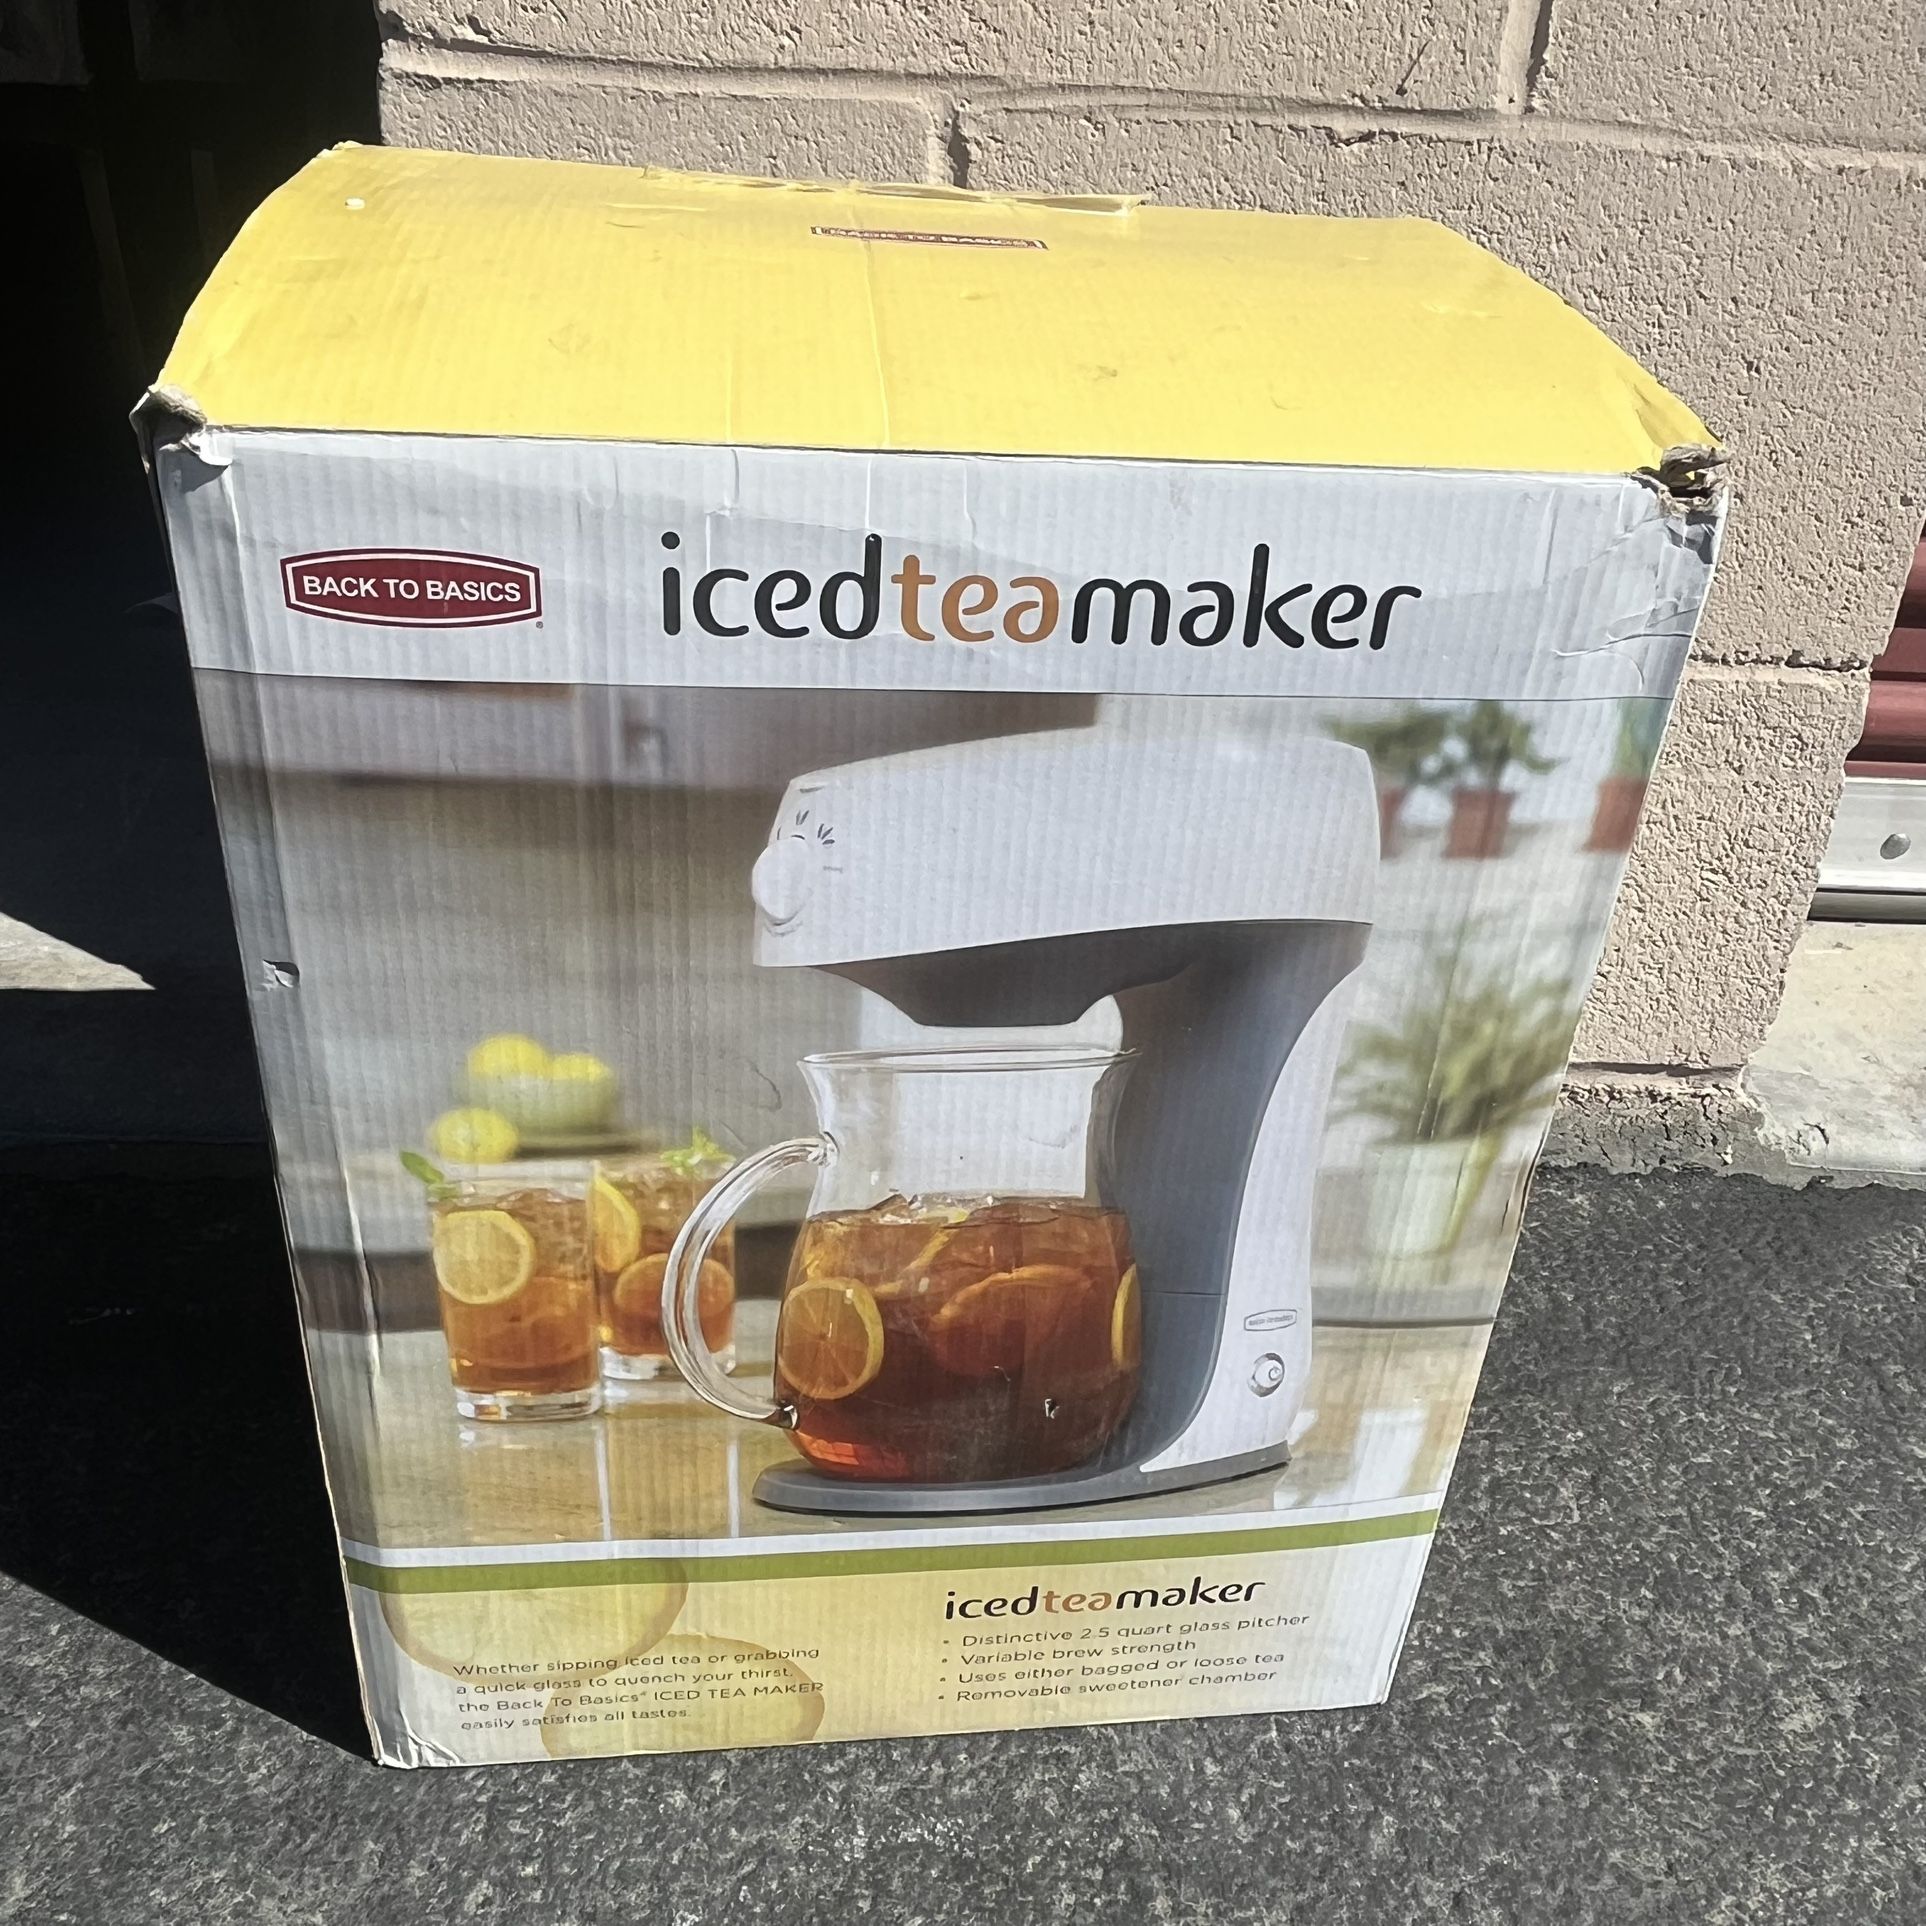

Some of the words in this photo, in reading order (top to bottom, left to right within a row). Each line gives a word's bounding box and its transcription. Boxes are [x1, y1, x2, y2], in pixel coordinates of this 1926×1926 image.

[302, 574, 379, 600] BACK
[382, 577, 420, 600] TO
[426, 579, 521, 603] BASICS
[661, 531, 1423, 651] icedteamaker
[963, 1631, 1073, 1647] Distinctive
[1117, 1623, 1172, 1638] quart
[1179, 1620, 1231, 1635] glass
[1237, 1615, 1310, 1630] pitcher
[453, 1663, 540, 1676] Whether
[547, 1658, 618, 1672] sipping
[625, 1656, 664, 1667] iced
[672, 1655, 701, 1665] tea
[708, 1654, 726, 1664] or
[734, 1649, 819, 1664] grabbing
[961, 1650, 1045, 1665] Variable
[1052, 1649, 1103, 1659] brew
[1111, 1640, 1196, 1656] strength
[959, 1672, 1007, 1683] Uses
[1014, 1667, 1074, 1680] either
[1081, 1660, 1159, 1675] bagged
[1166, 1660, 1188, 1670] or
[1194, 1656, 1248, 1667] loose
[1254, 1653, 1284, 1664] tea
[456, 1686, 467, 1695] a
[474, 1681, 527, 1695] quick
[533, 1679, 582, 1692] glass
[588, 1678, 607, 1687] to
[614, 1673, 685, 1686] quench
[692, 1673, 734, 1684] your
[458, 1703, 490, 1713] the
[496, 1699, 544, 1711] Back
[550, 1697, 573, 1707] To
[654, 1690, 701, 1701] ICED
[707, 1688, 747, 1699] TEA
[753, 1682, 824, 1696] MAKER
[957, 1685, 1071, 1702] Removable
[1079, 1678, 1182, 1693] sweetener
[1188, 1671, 1277, 1686] chamber
[461, 1718, 514, 1731] easily
[522, 1713, 598, 1727] satisfies
[604, 1711, 625, 1721] all
